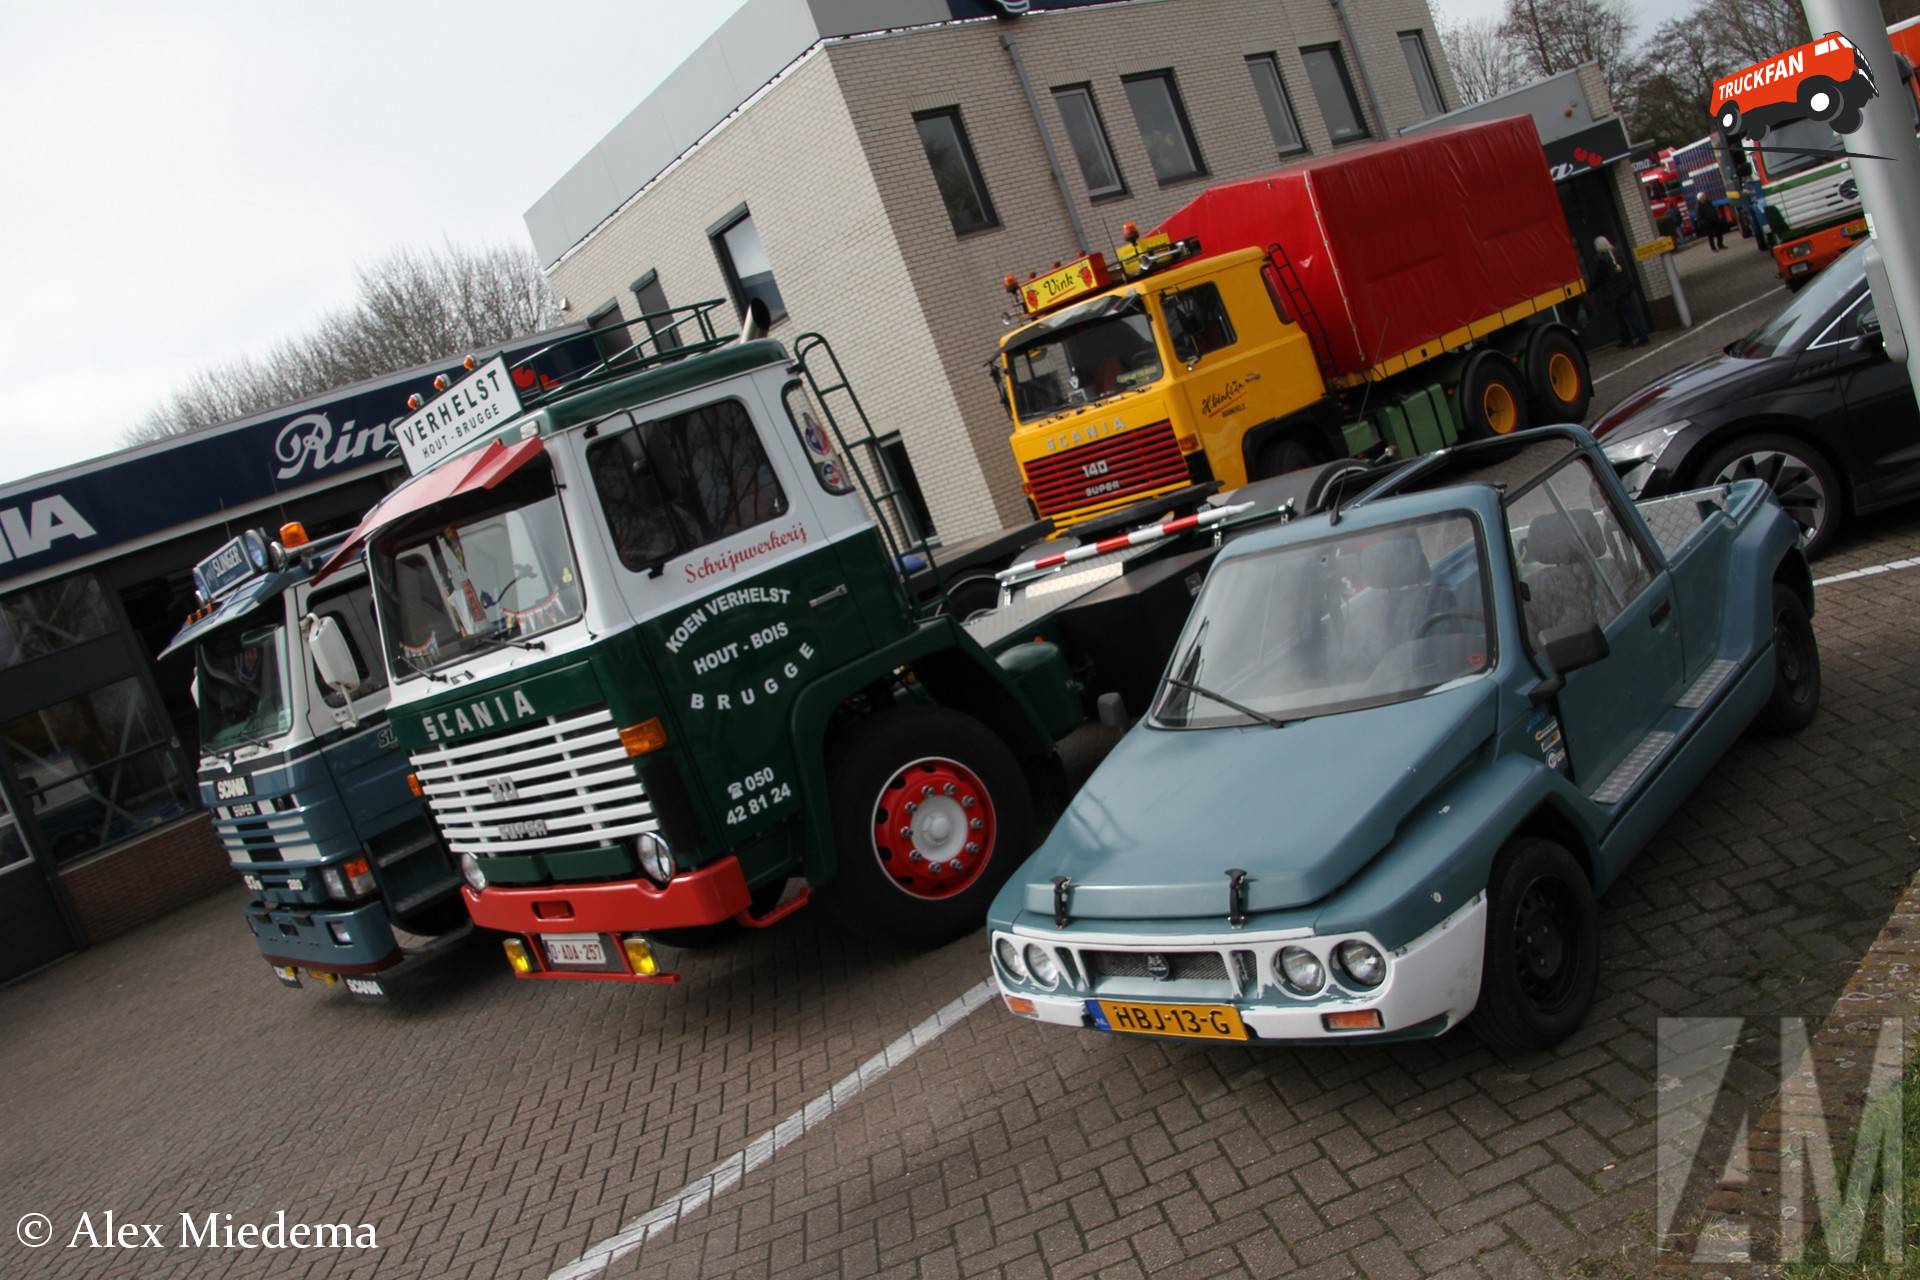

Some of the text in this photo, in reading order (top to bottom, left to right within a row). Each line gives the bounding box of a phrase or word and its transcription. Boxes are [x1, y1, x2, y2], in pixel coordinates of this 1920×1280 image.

[1043, 272, 1075, 296] Vink
[402, 369, 501, 448] VERHELST
[423, 437, 449, 459] HOUT
[456, 403, 500, 438] BRUGGE
[1046, 416, 1125, 451] SCANIA
[1082, 459, 1110, 478] 140
[1085, 479, 1120, 497] SUPER
[0, 493, 99, 565] IA
[684, 521, 808, 584] Schrijnwerkerij
[665, 586, 791, 654] KOEN VERHELST
[692, 642, 741, 675] HOUT
[750, 621, 789, 649] BOIS
[690, 642, 815, 710] BRUGGE
[422, 689, 536, 741] SCANIA
[217, 776, 249, 800] SCANIA
[744, 766, 774, 791] 050
[232, 803, 256, 817] SUPER
[726, 782, 791, 824] 42 81 24
[498, 819, 548, 840] SUPER
[346, 978, 384, 996] SCANIA
[1112, 1005, 1231, 1035] HBJ-13-G
